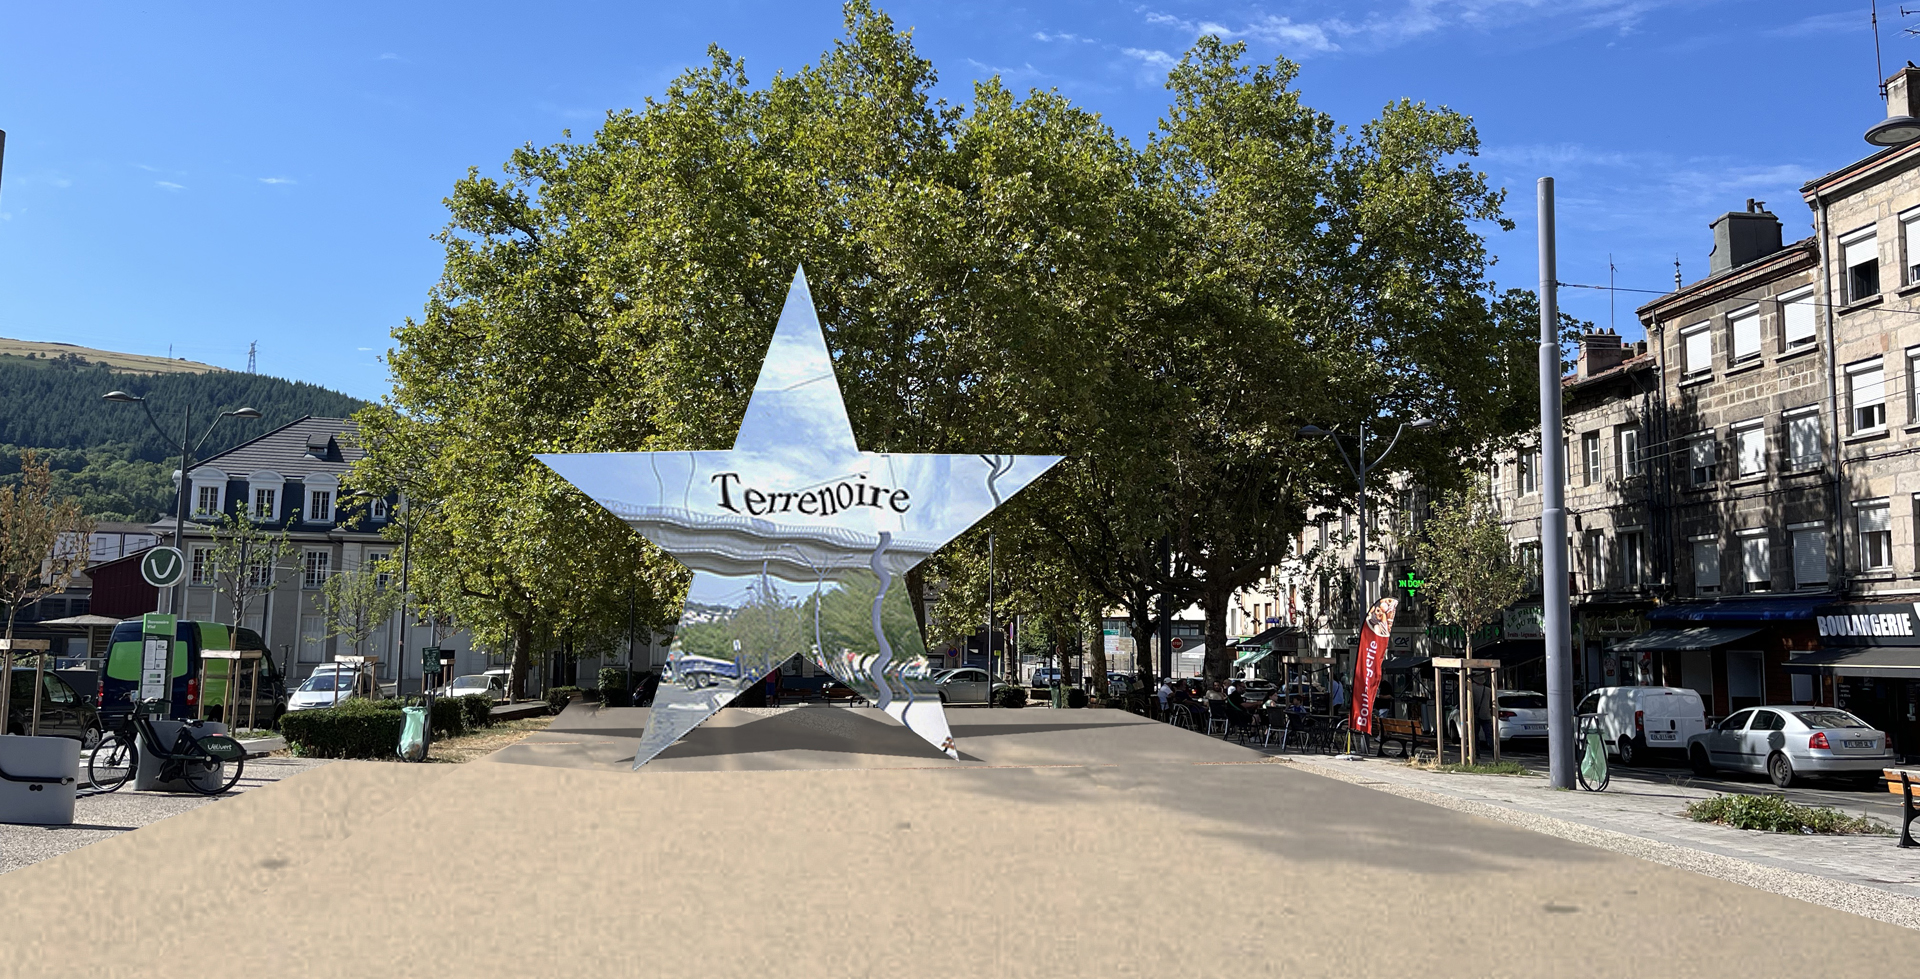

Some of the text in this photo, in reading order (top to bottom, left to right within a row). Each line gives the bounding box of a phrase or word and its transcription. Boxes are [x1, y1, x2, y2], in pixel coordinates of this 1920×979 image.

[711, 473, 911, 517] Terrenoire
[150, 554, 177, 579] V
[1516, 619, 1526, 630] DU
[1816, 613, 1914, 638] BOULANGERIE
[1356, 640, 1378, 727] Boulagerie
